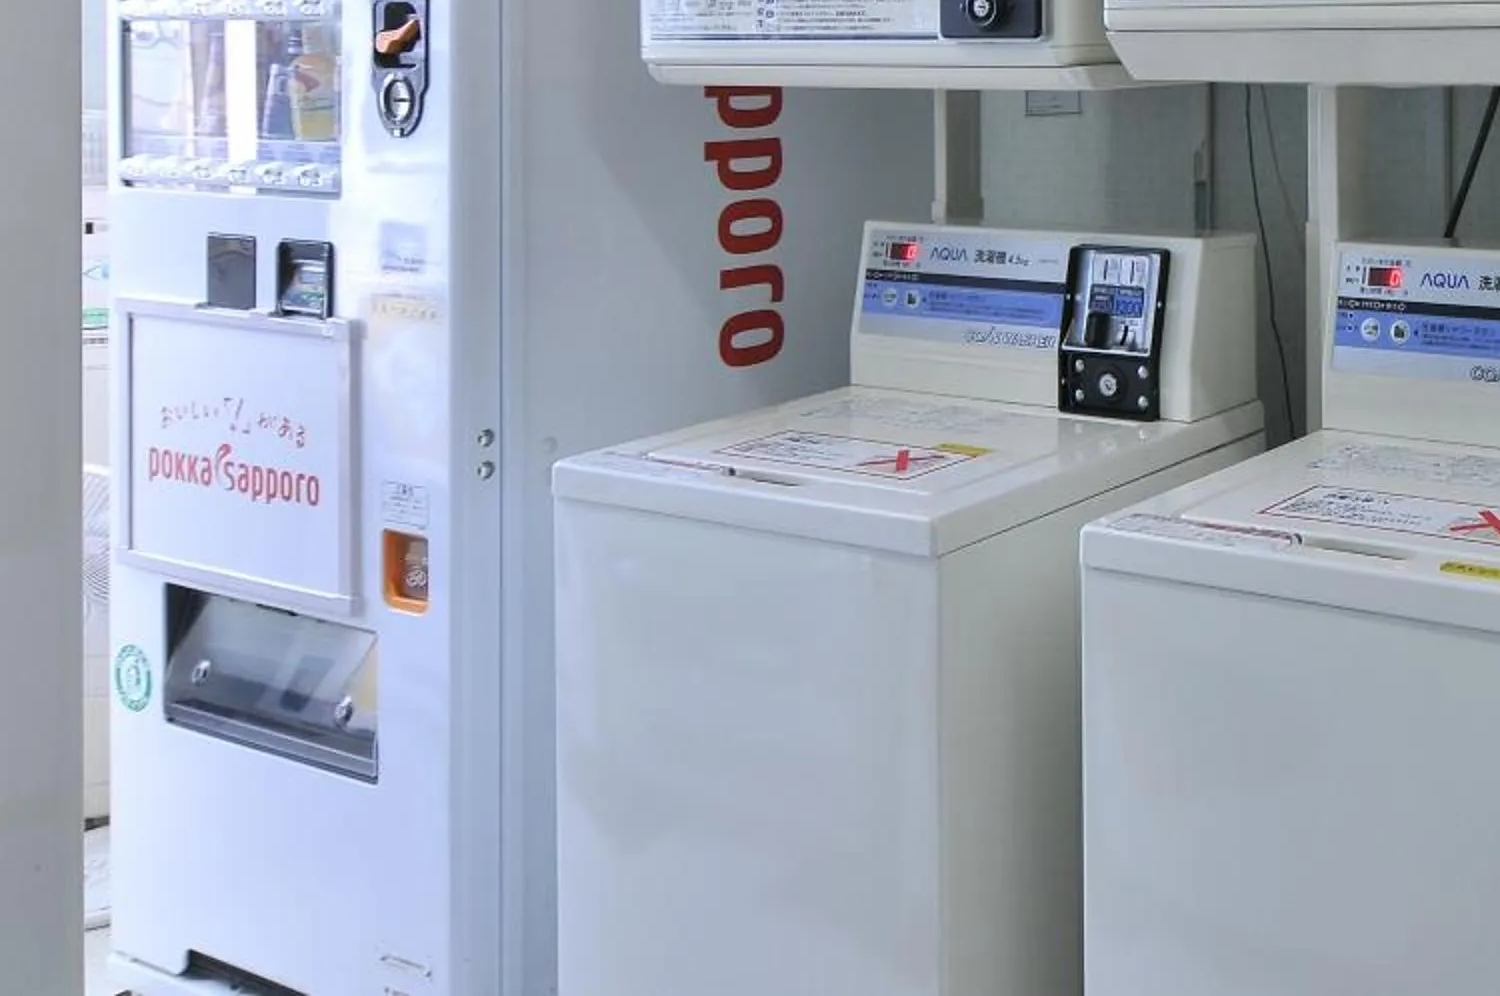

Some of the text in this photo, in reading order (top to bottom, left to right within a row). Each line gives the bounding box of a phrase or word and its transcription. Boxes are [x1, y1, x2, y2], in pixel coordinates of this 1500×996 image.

[929, 247, 969, 262] AQUA
[1389, 269, 1401, 287] 0
[1420, 272, 1470, 289] AQUA
[149, 446, 320, 506] pokka sapporo
